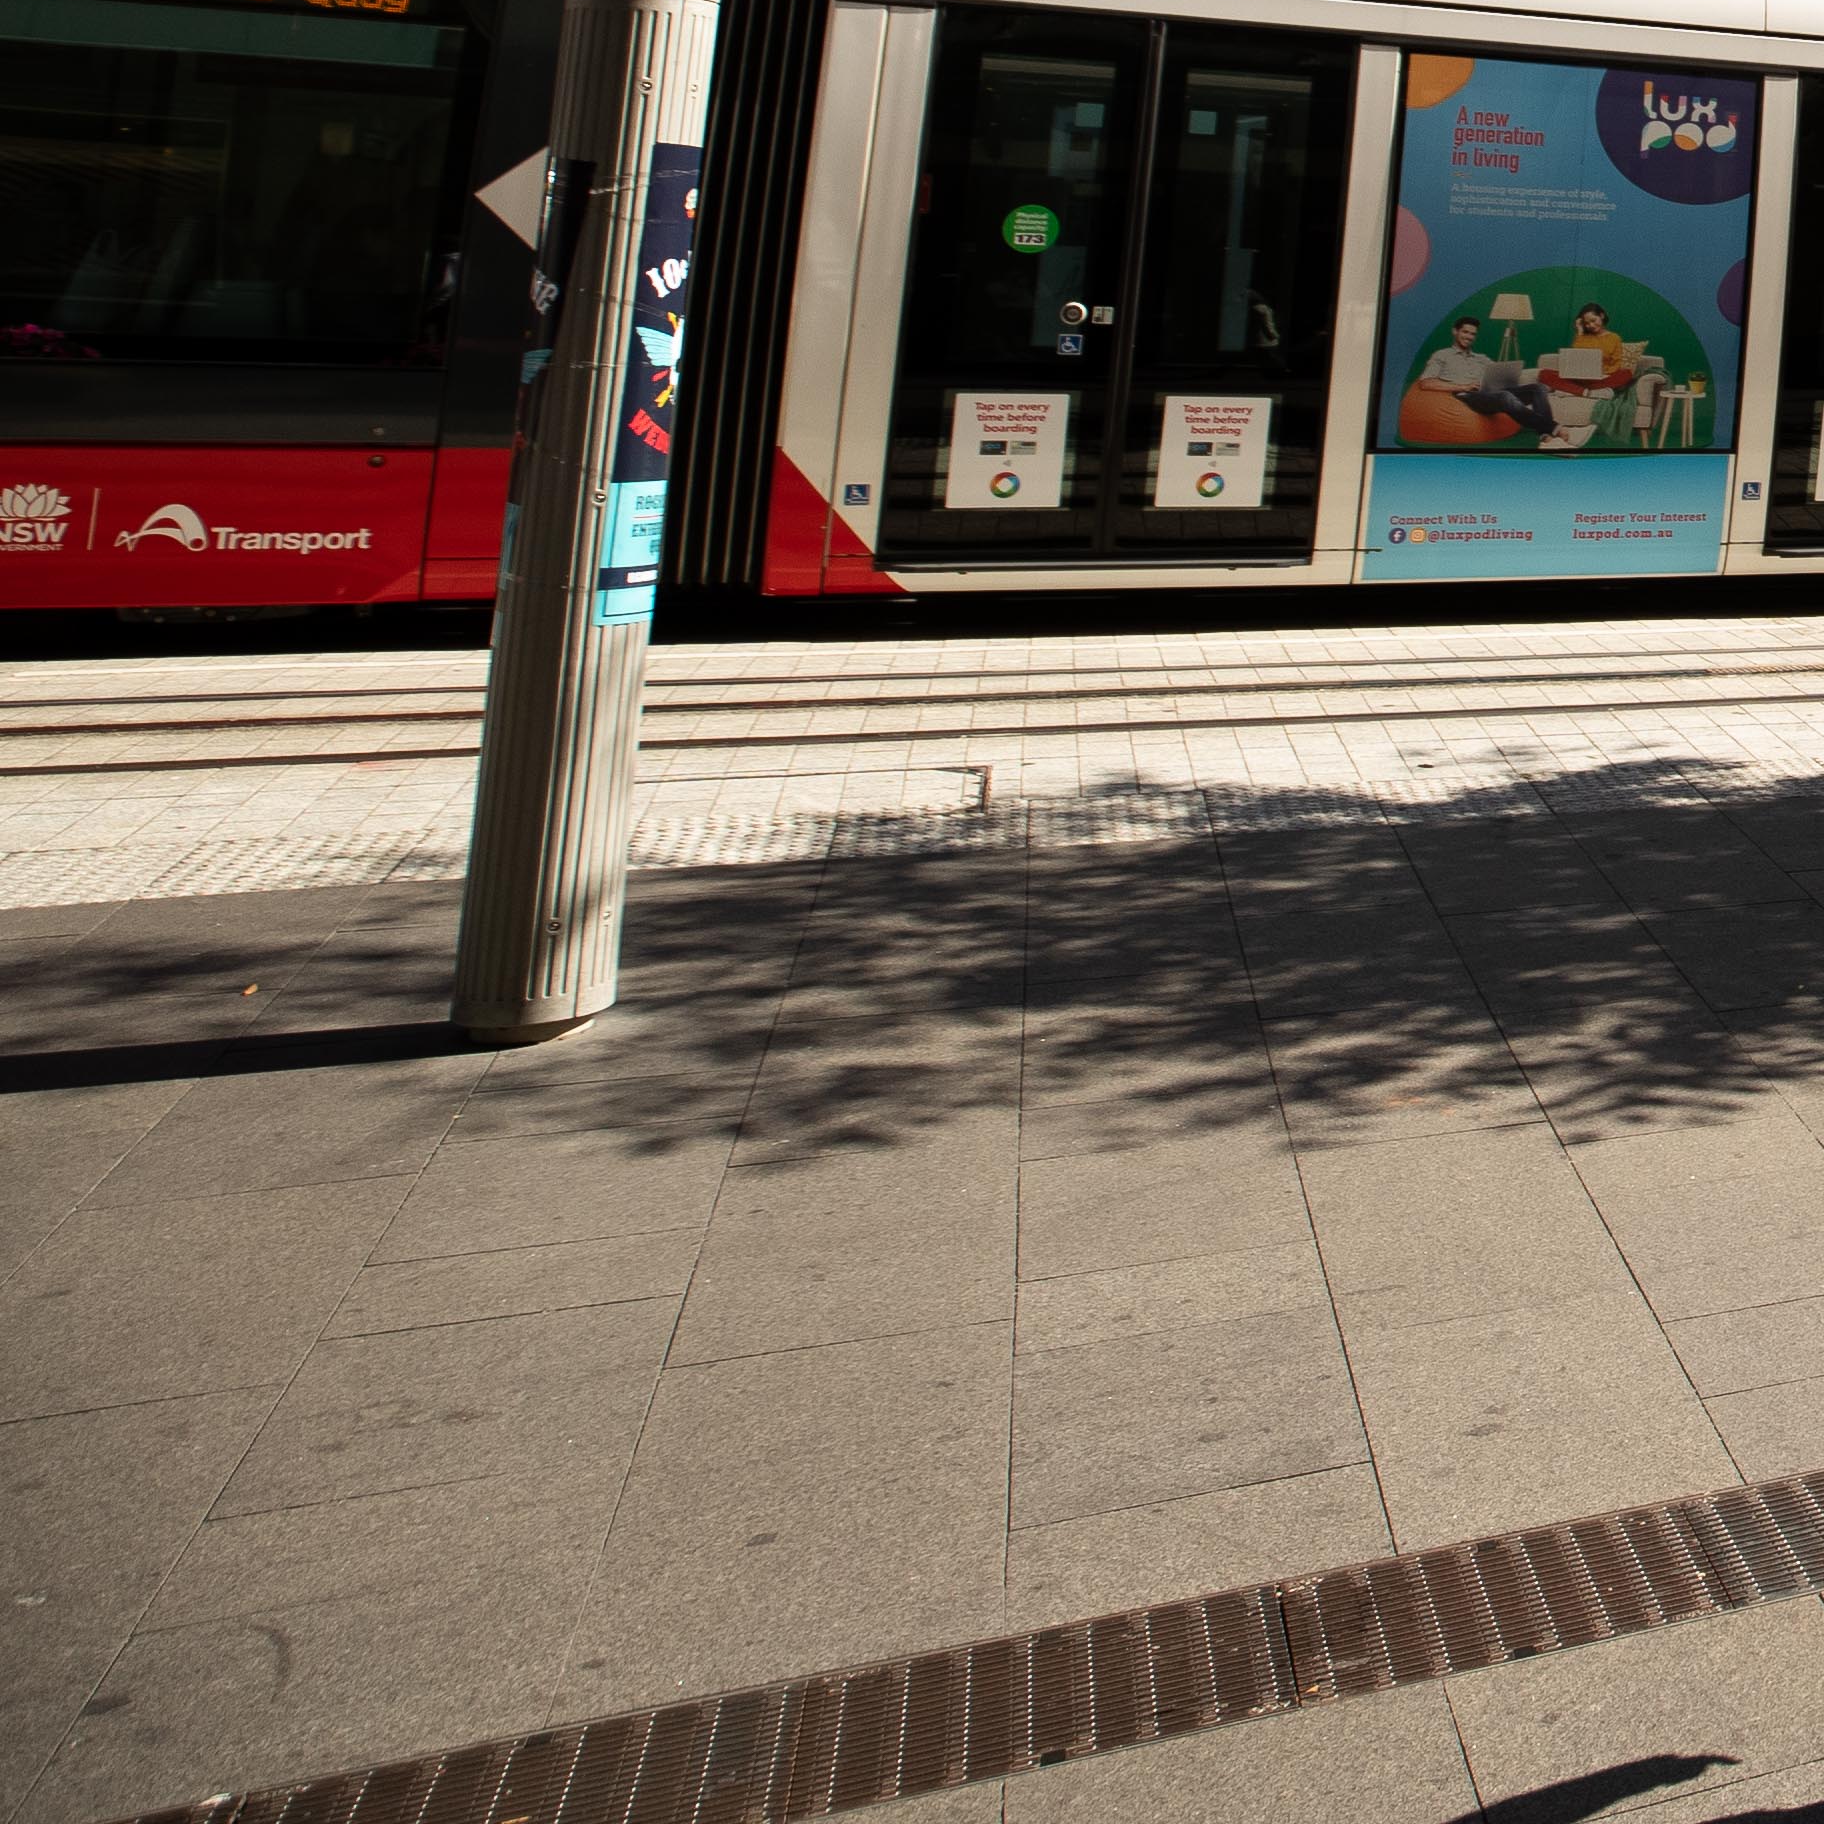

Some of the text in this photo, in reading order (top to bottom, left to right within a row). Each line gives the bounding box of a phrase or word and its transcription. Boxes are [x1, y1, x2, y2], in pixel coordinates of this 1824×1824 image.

[1643, 80, 1718, 123] lux
[1457, 106, 1510, 127] A new
[1453, 126, 1545, 147] generation
[1640, 113, 1738, 160] pod
[1452, 147, 1519, 173] in living
[975, 402, 995, 412] Tap
[1017, 404, 1050, 413] every
[1183, 404, 1202, 414] Tap
[1223, 406, 1253, 415] every
[976, 412, 1046, 422] time before
[1185, 415, 1249, 424] time before
[984, 424, 1037, 434] boarding
[1190, 426, 1241, 436] boarding
[1390, 514, 1498, 525] Connect With Us
[1574, 512, 1707, 525] Register Your Interest
[0, 522, 69, 543] NSW
[1428, 529, 1533, 543] @luxpodliving
[1572, 528, 1673, 541] luxpod.com.au
[211, 527, 373, 555] Transport
